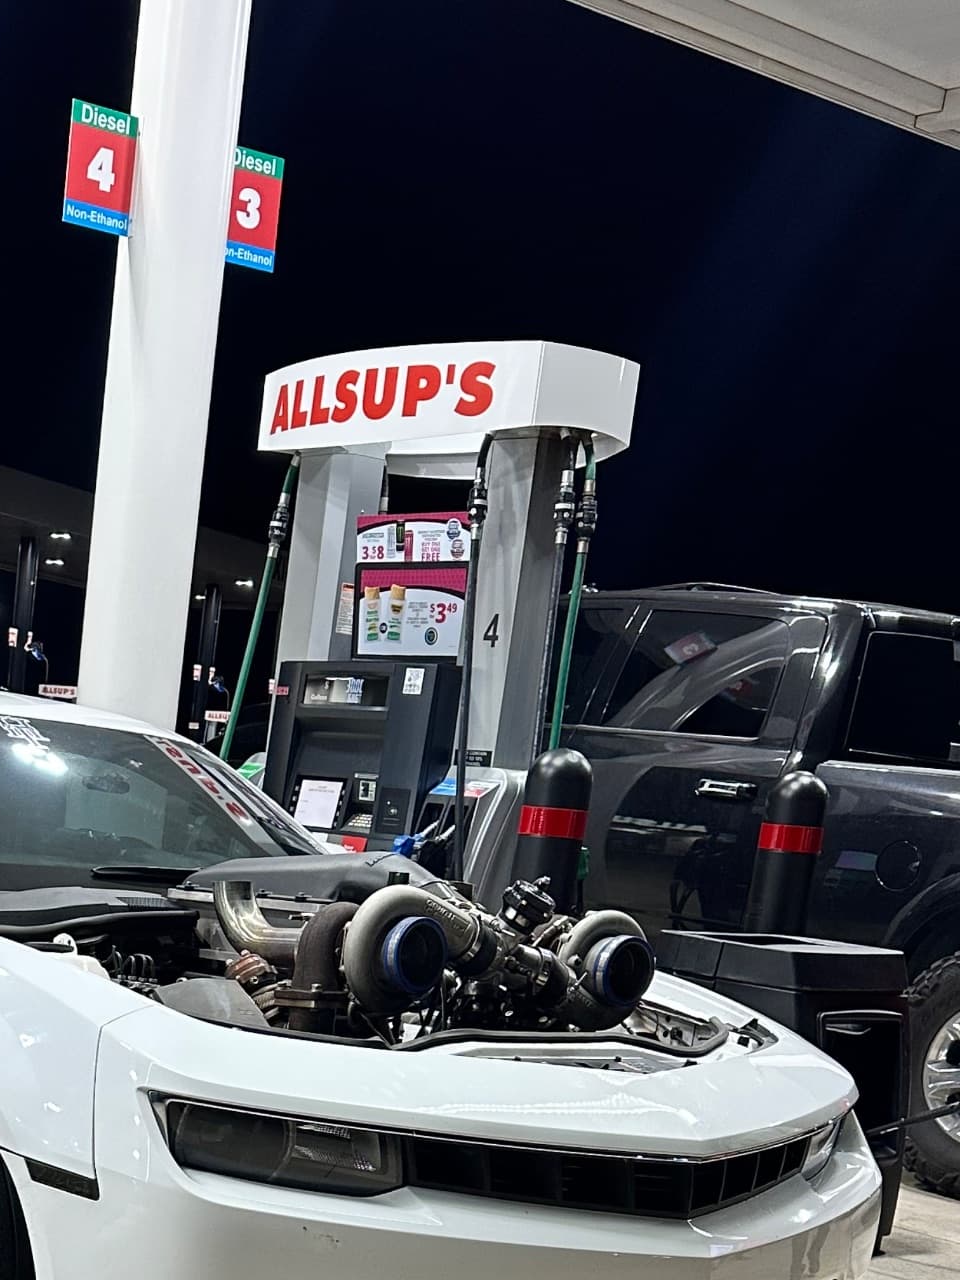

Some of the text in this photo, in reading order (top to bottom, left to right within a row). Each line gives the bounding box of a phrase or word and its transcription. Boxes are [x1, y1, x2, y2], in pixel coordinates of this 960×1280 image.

[81, 103, 130, 135] Diesel
[87, 147, 115, 192] 4
[66, 204, 128, 231] Non-Ethanol
[236, 187, 261, 229] 3
[224, 247, 273, 267] on-Ethanol
[270, 361, 496, 435] ALLSUP'S
[421, 552, 441, 562] FREE
[483, 613, 500, 648] 4
[41, 685, 76, 696] ALLSUP'S
